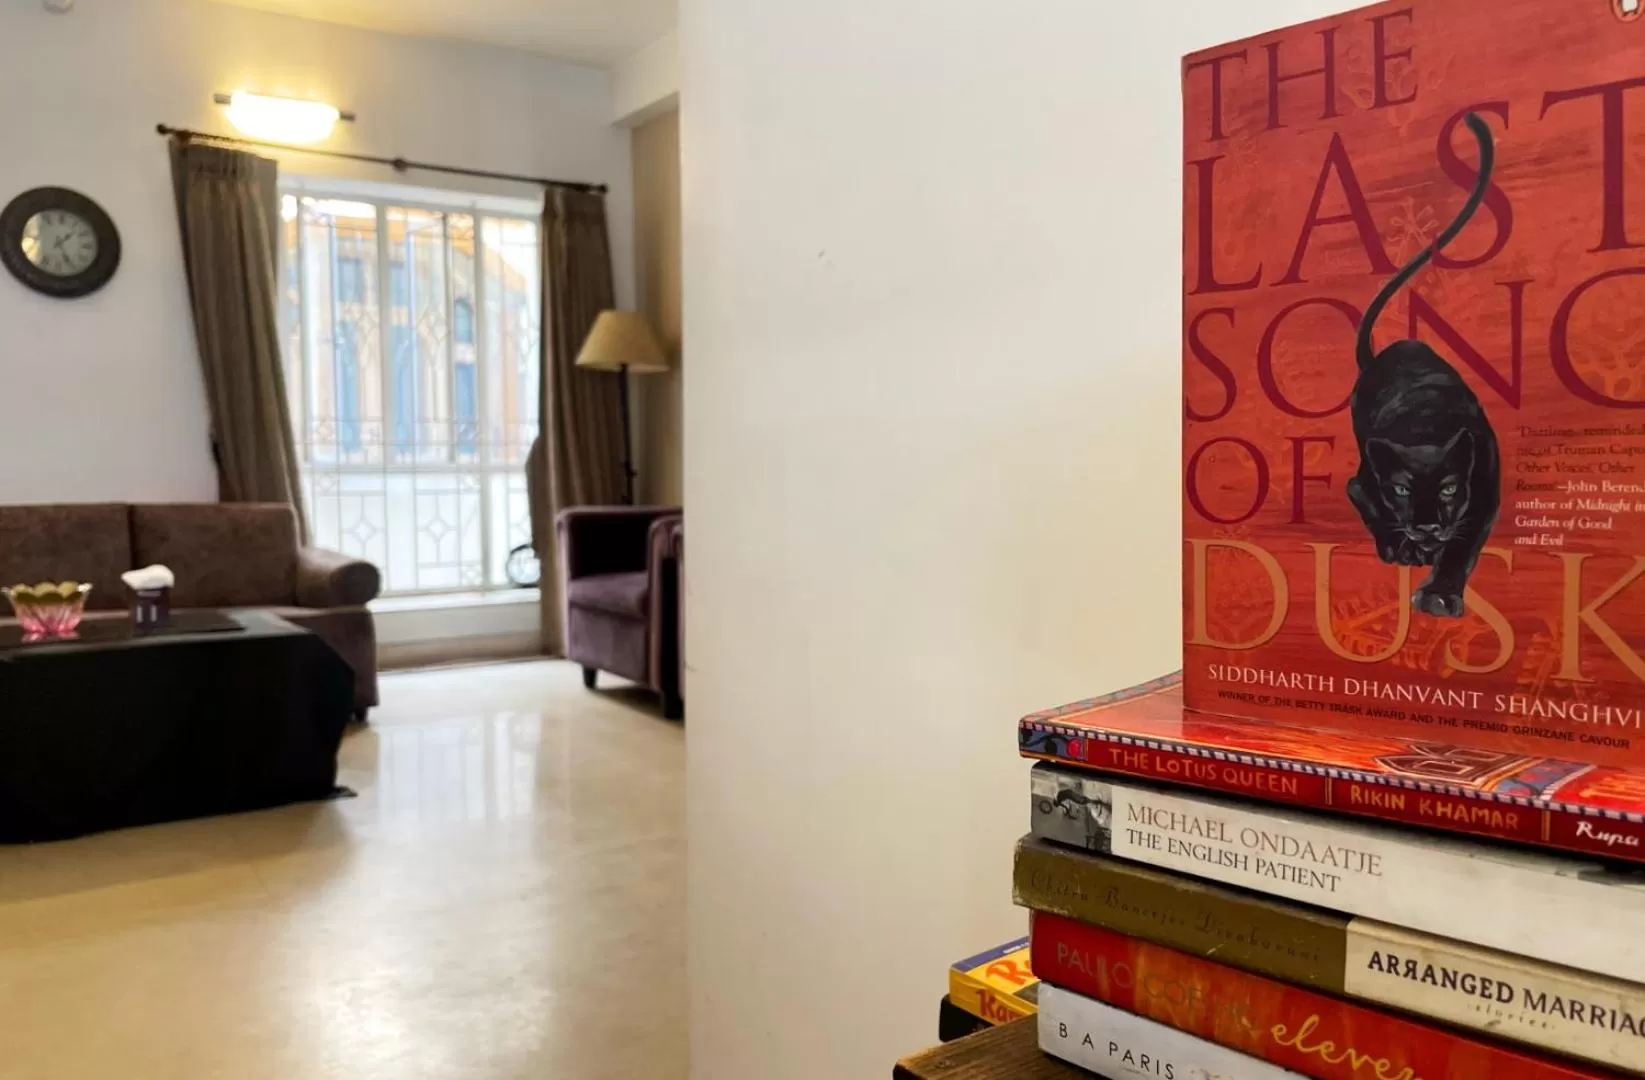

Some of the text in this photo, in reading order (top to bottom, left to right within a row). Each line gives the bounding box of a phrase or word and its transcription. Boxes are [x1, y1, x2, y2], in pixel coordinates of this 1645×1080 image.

[1186, 8, 1419, 141] THE
[1187, 77, 1645, 296] LAST
[1186, 436, 1335, 525] OF
[1515, 498, 1557, 510] author
[1560, 499, 1573, 510] of
[1576, 498, 1631, 513] Midnight
[1514, 533, 1564, 546] and Evil
[1515, 515, 1613, 531] Garden of Good
[1184, 537, 1645, 684] DUSK
[1208, 663, 1641, 729] SIDDHARTH DHANVANT SHANGHVI
[1217, 690, 1256, 701] WINNER
[1257, 695, 1270, 704] OF
[1273, 697, 1291, 707] THE
[1295, 699, 1325, 711] BETTY
[1366, 708, 1407, 722] AWARD
[1410, 713, 1434, 724] AND
[1438, 715, 1458, 728] THE
[1463, 719, 1509, 734] PREMIO
[1512, 726, 1576, 742] GRINZANE
[1579, 733, 1630, 749] CAVOUR
[1109, 748, 1297, 795] THE LOTUS QUEEN
[1350, 784, 1519, 829] RIKIN KHAMAR
[1576, 820, 1640, 847] Rupa
[1126, 828, 1342, 893] THE ENGLISH PATIENT
[1127, 803, 1383, 877] MICHAEL ONDAATJE
[1059, 1022, 1174, 1080] B A PARIS
